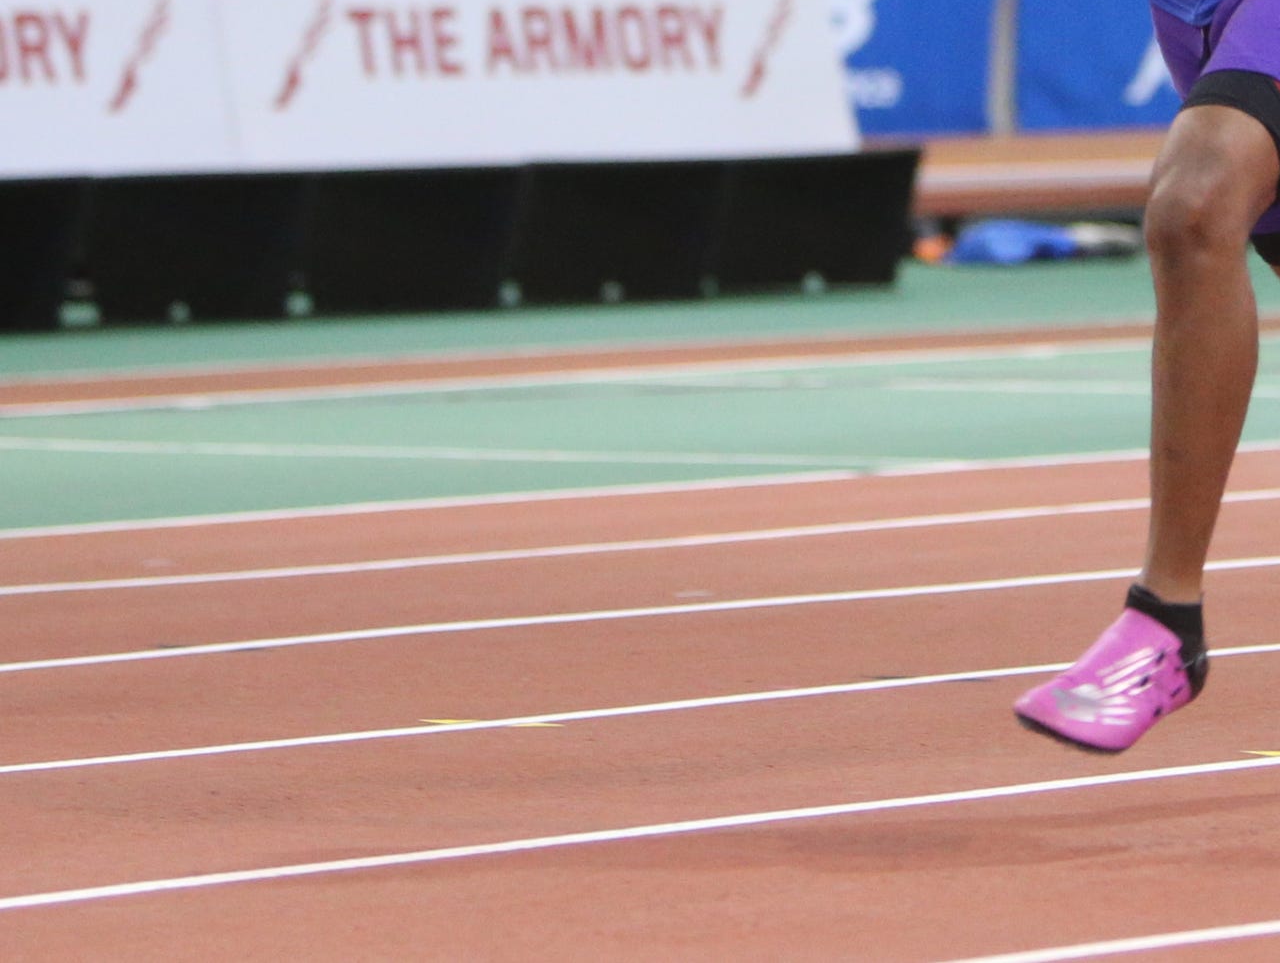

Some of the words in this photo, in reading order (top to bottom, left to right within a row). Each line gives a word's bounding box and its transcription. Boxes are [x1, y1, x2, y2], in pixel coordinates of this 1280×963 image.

[0, 10, 90, 84] RY
[346, 4, 464, 78] THE
[484, 1, 726, 73] ARMORY
